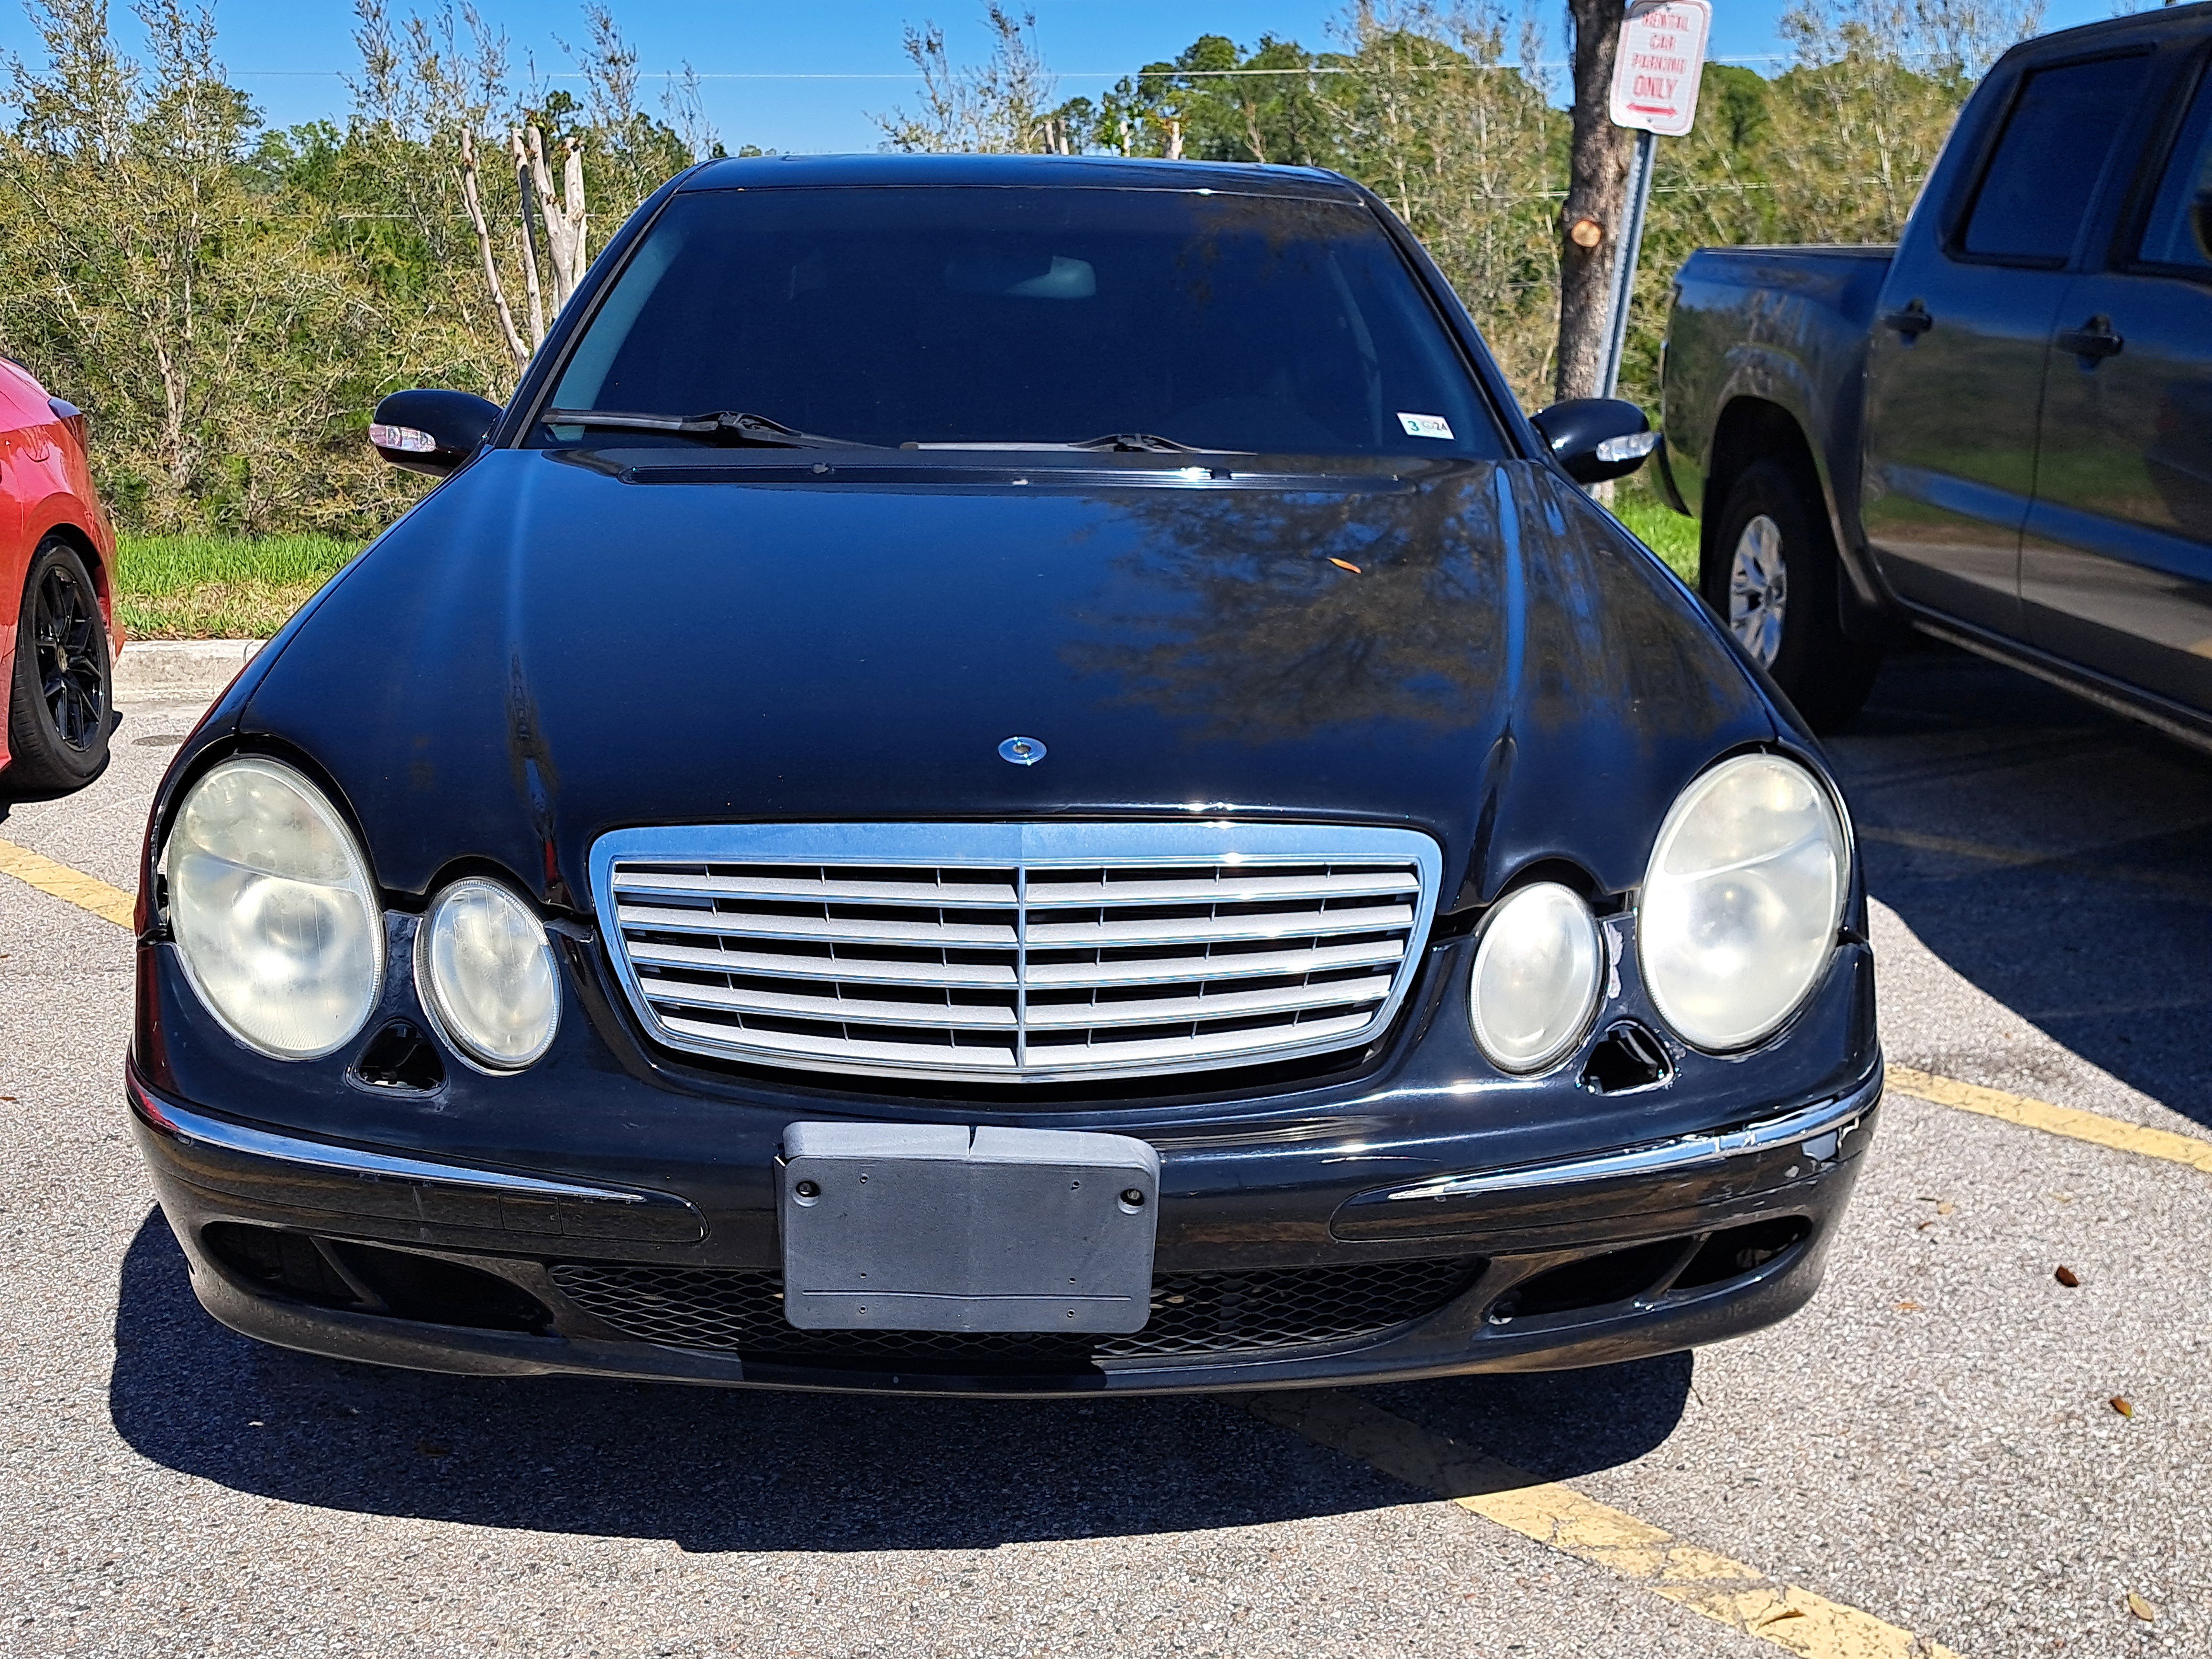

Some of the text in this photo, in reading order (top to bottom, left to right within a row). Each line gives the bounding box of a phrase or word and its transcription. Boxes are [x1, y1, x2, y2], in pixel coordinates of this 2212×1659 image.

[1650, 34, 1676, 50] CAR
[1632, 54, 1686, 74] PARKING
[1633, 76, 1678, 99] ONLY
[1407, 420, 1448, 431] 3 24
